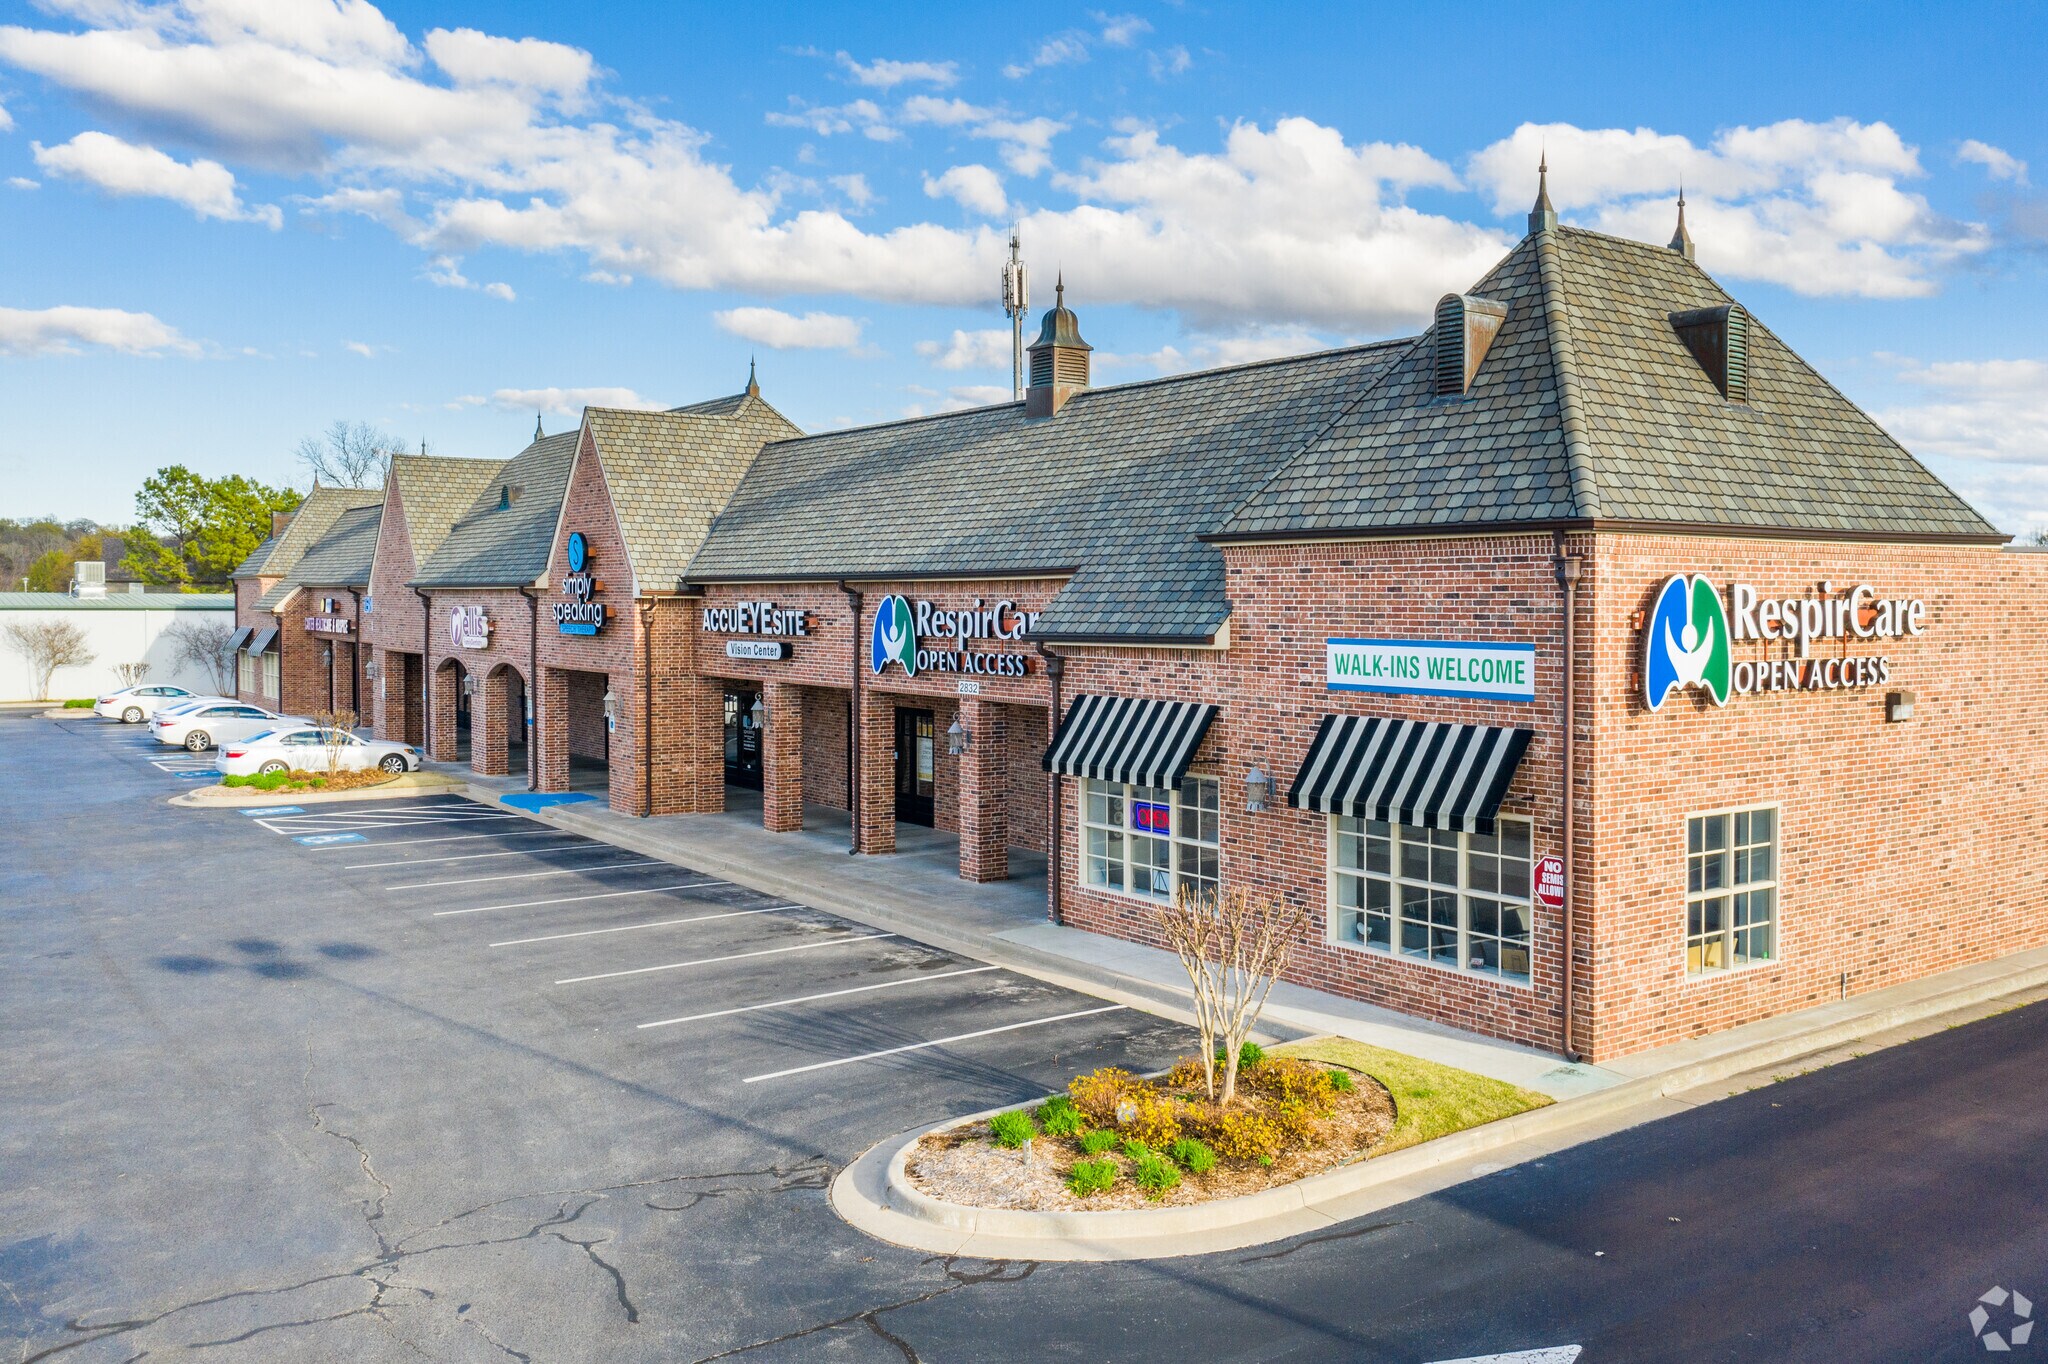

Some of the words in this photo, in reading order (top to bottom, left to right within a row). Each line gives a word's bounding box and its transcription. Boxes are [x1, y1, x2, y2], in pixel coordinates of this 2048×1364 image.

[562, 573, 592, 600] simply
[552, 598, 602, 628] speaking
[702, 602, 805, 636] ACCUEYESITE
[917, 599, 1039, 651] RespirCar
[1733, 581, 1926, 658] RespirCare
[730, 643, 752, 656] Vision
[753, 643, 778, 657] Center
[917, 650, 958, 673] OPEN
[963, 653, 1025, 677] ACCESS
[1334, 652, 1420, 679] WALK-INS
[1427, 656, 1526, 685] WELCOME
[1733, 660, 1800, 693] OPEN
[1808, 656, 1889, 689] ACCESS
[959, 682, 978, 694] 2832
[1542, 873, 1563, 885] SEMIS
[1544, 861, 1562, 873] NO
[1538, 884, 1563, 897] ALLOW
